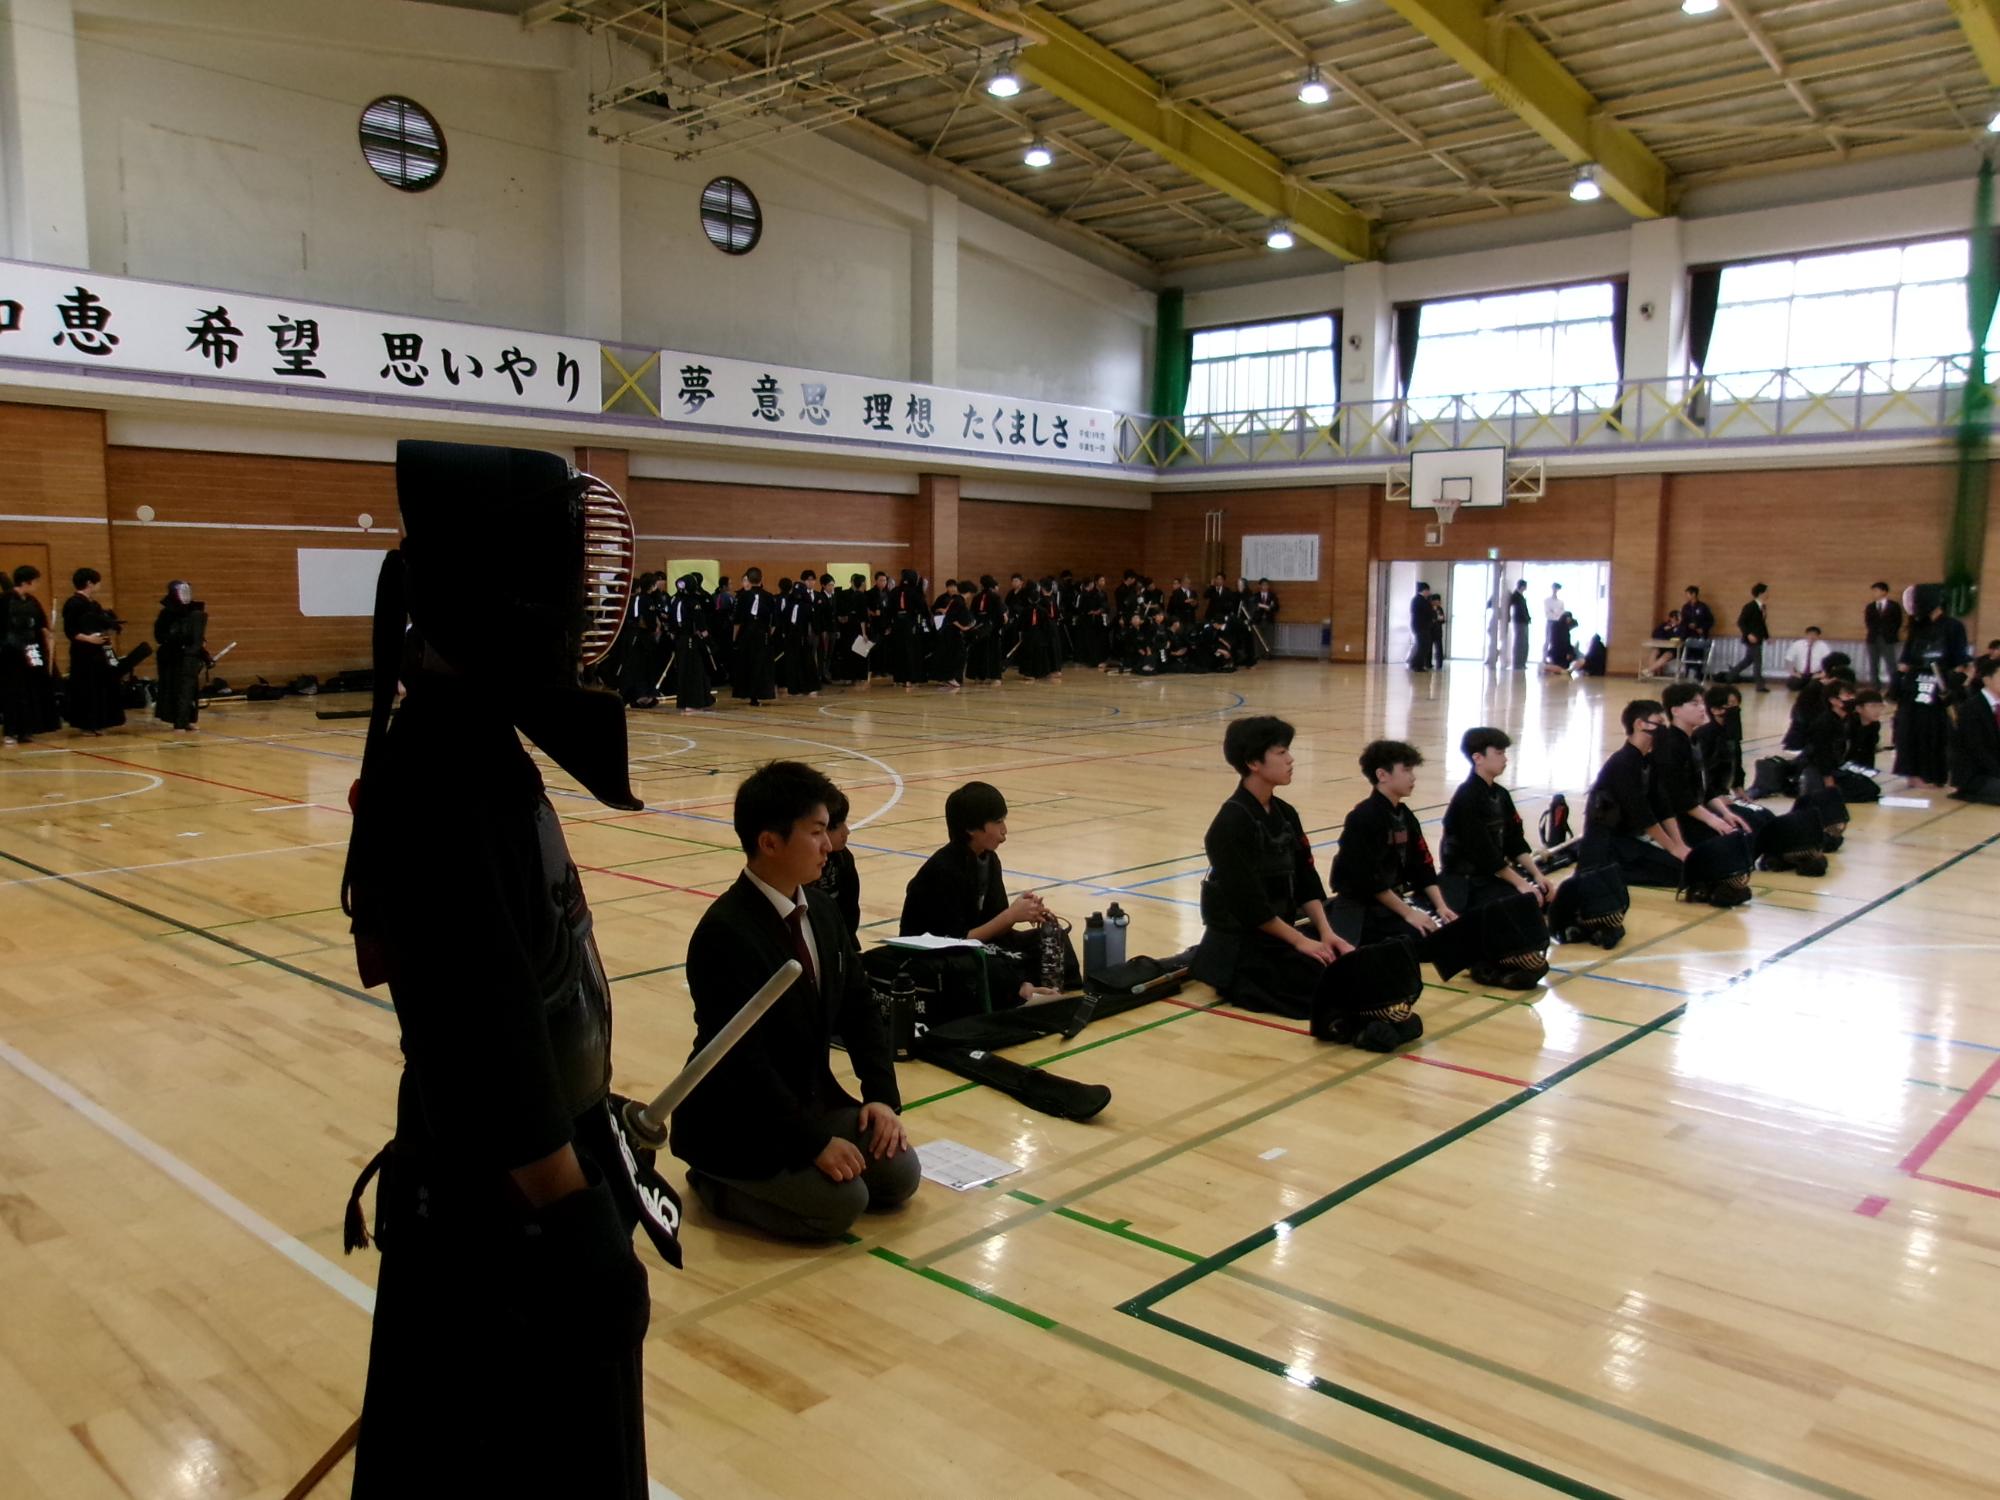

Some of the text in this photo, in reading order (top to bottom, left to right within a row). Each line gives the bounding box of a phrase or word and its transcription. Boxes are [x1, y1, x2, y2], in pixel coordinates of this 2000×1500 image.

[185, 305, 327, 379] 希望
[380, 332, 581, 403] 思いやり
[676, 364, 1069, 450] 夢 意思 理想 たくましさ
